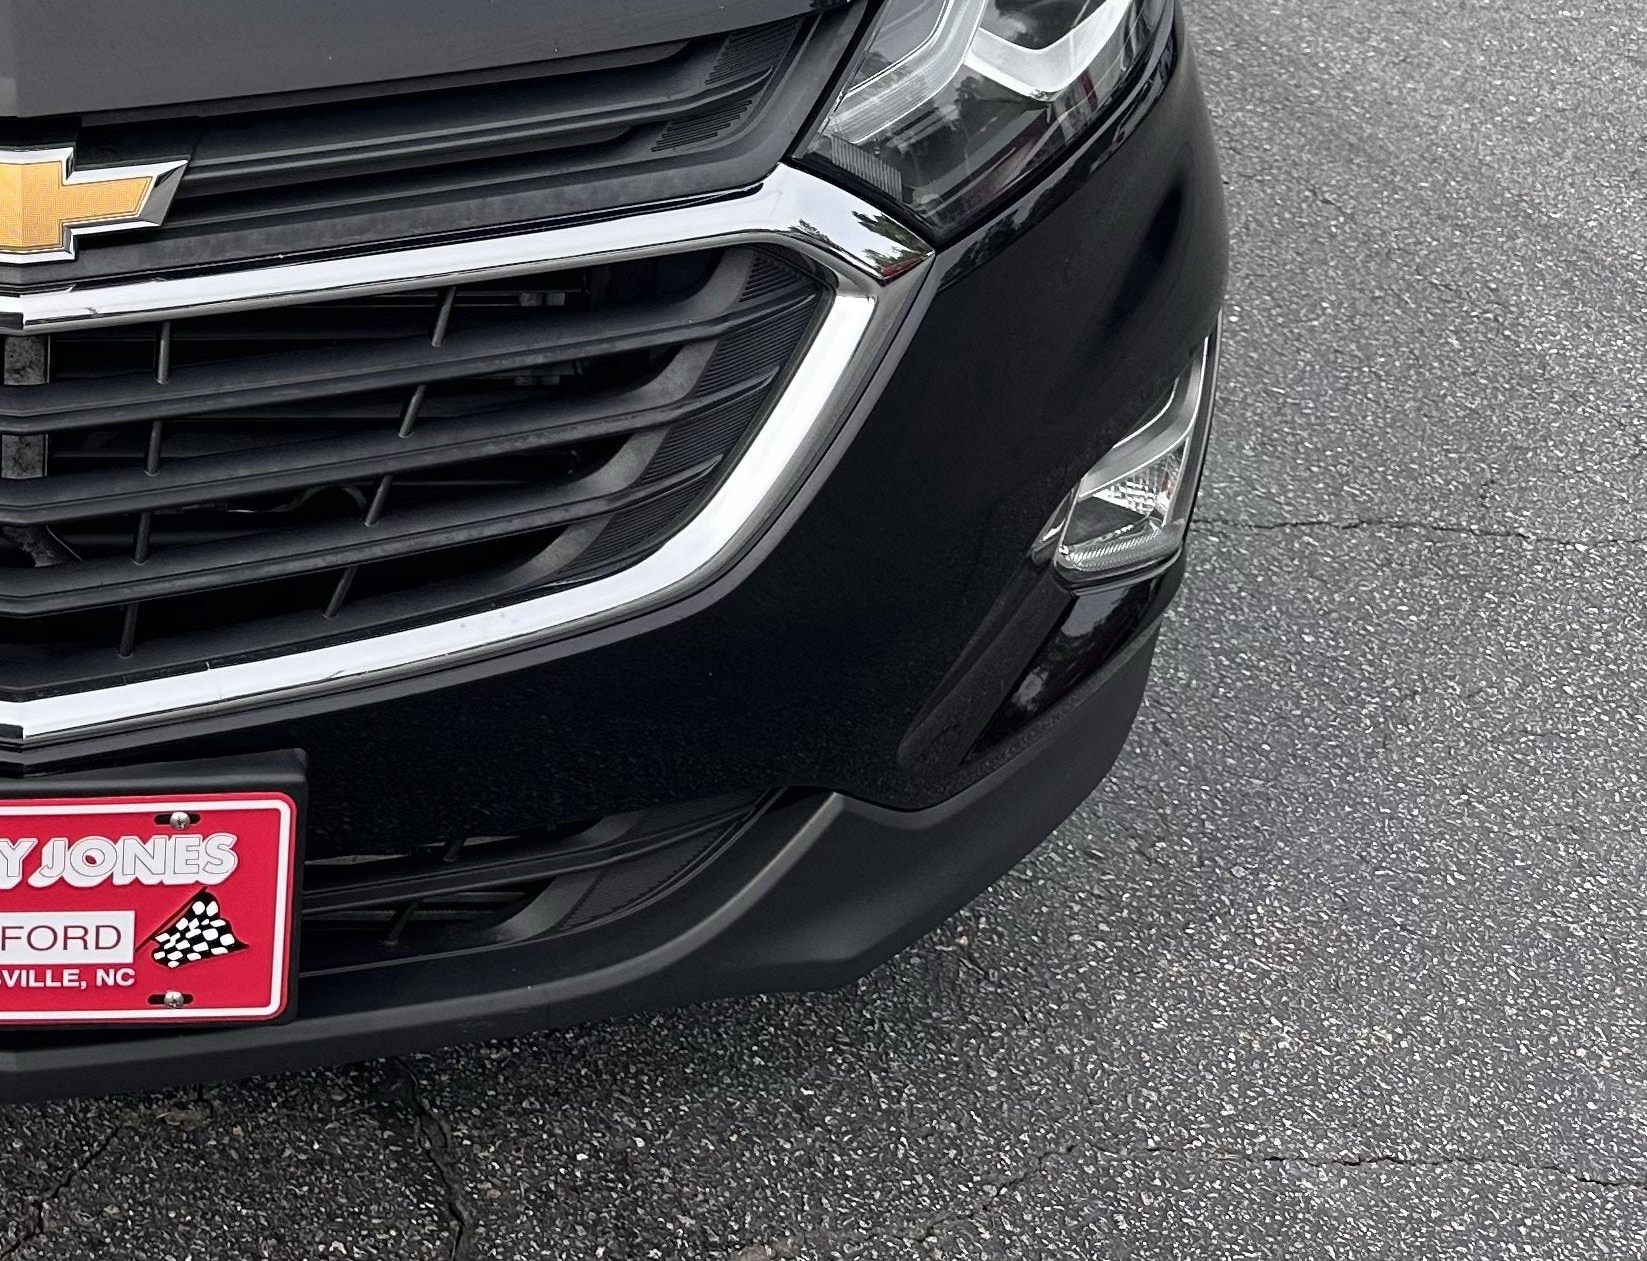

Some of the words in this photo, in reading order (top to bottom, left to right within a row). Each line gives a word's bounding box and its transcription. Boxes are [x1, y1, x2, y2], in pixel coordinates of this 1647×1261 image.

[27, 832, 238, 888] JONES
[0, 924, 122, 951] FORD
[95, 967, 136, 987] NC
